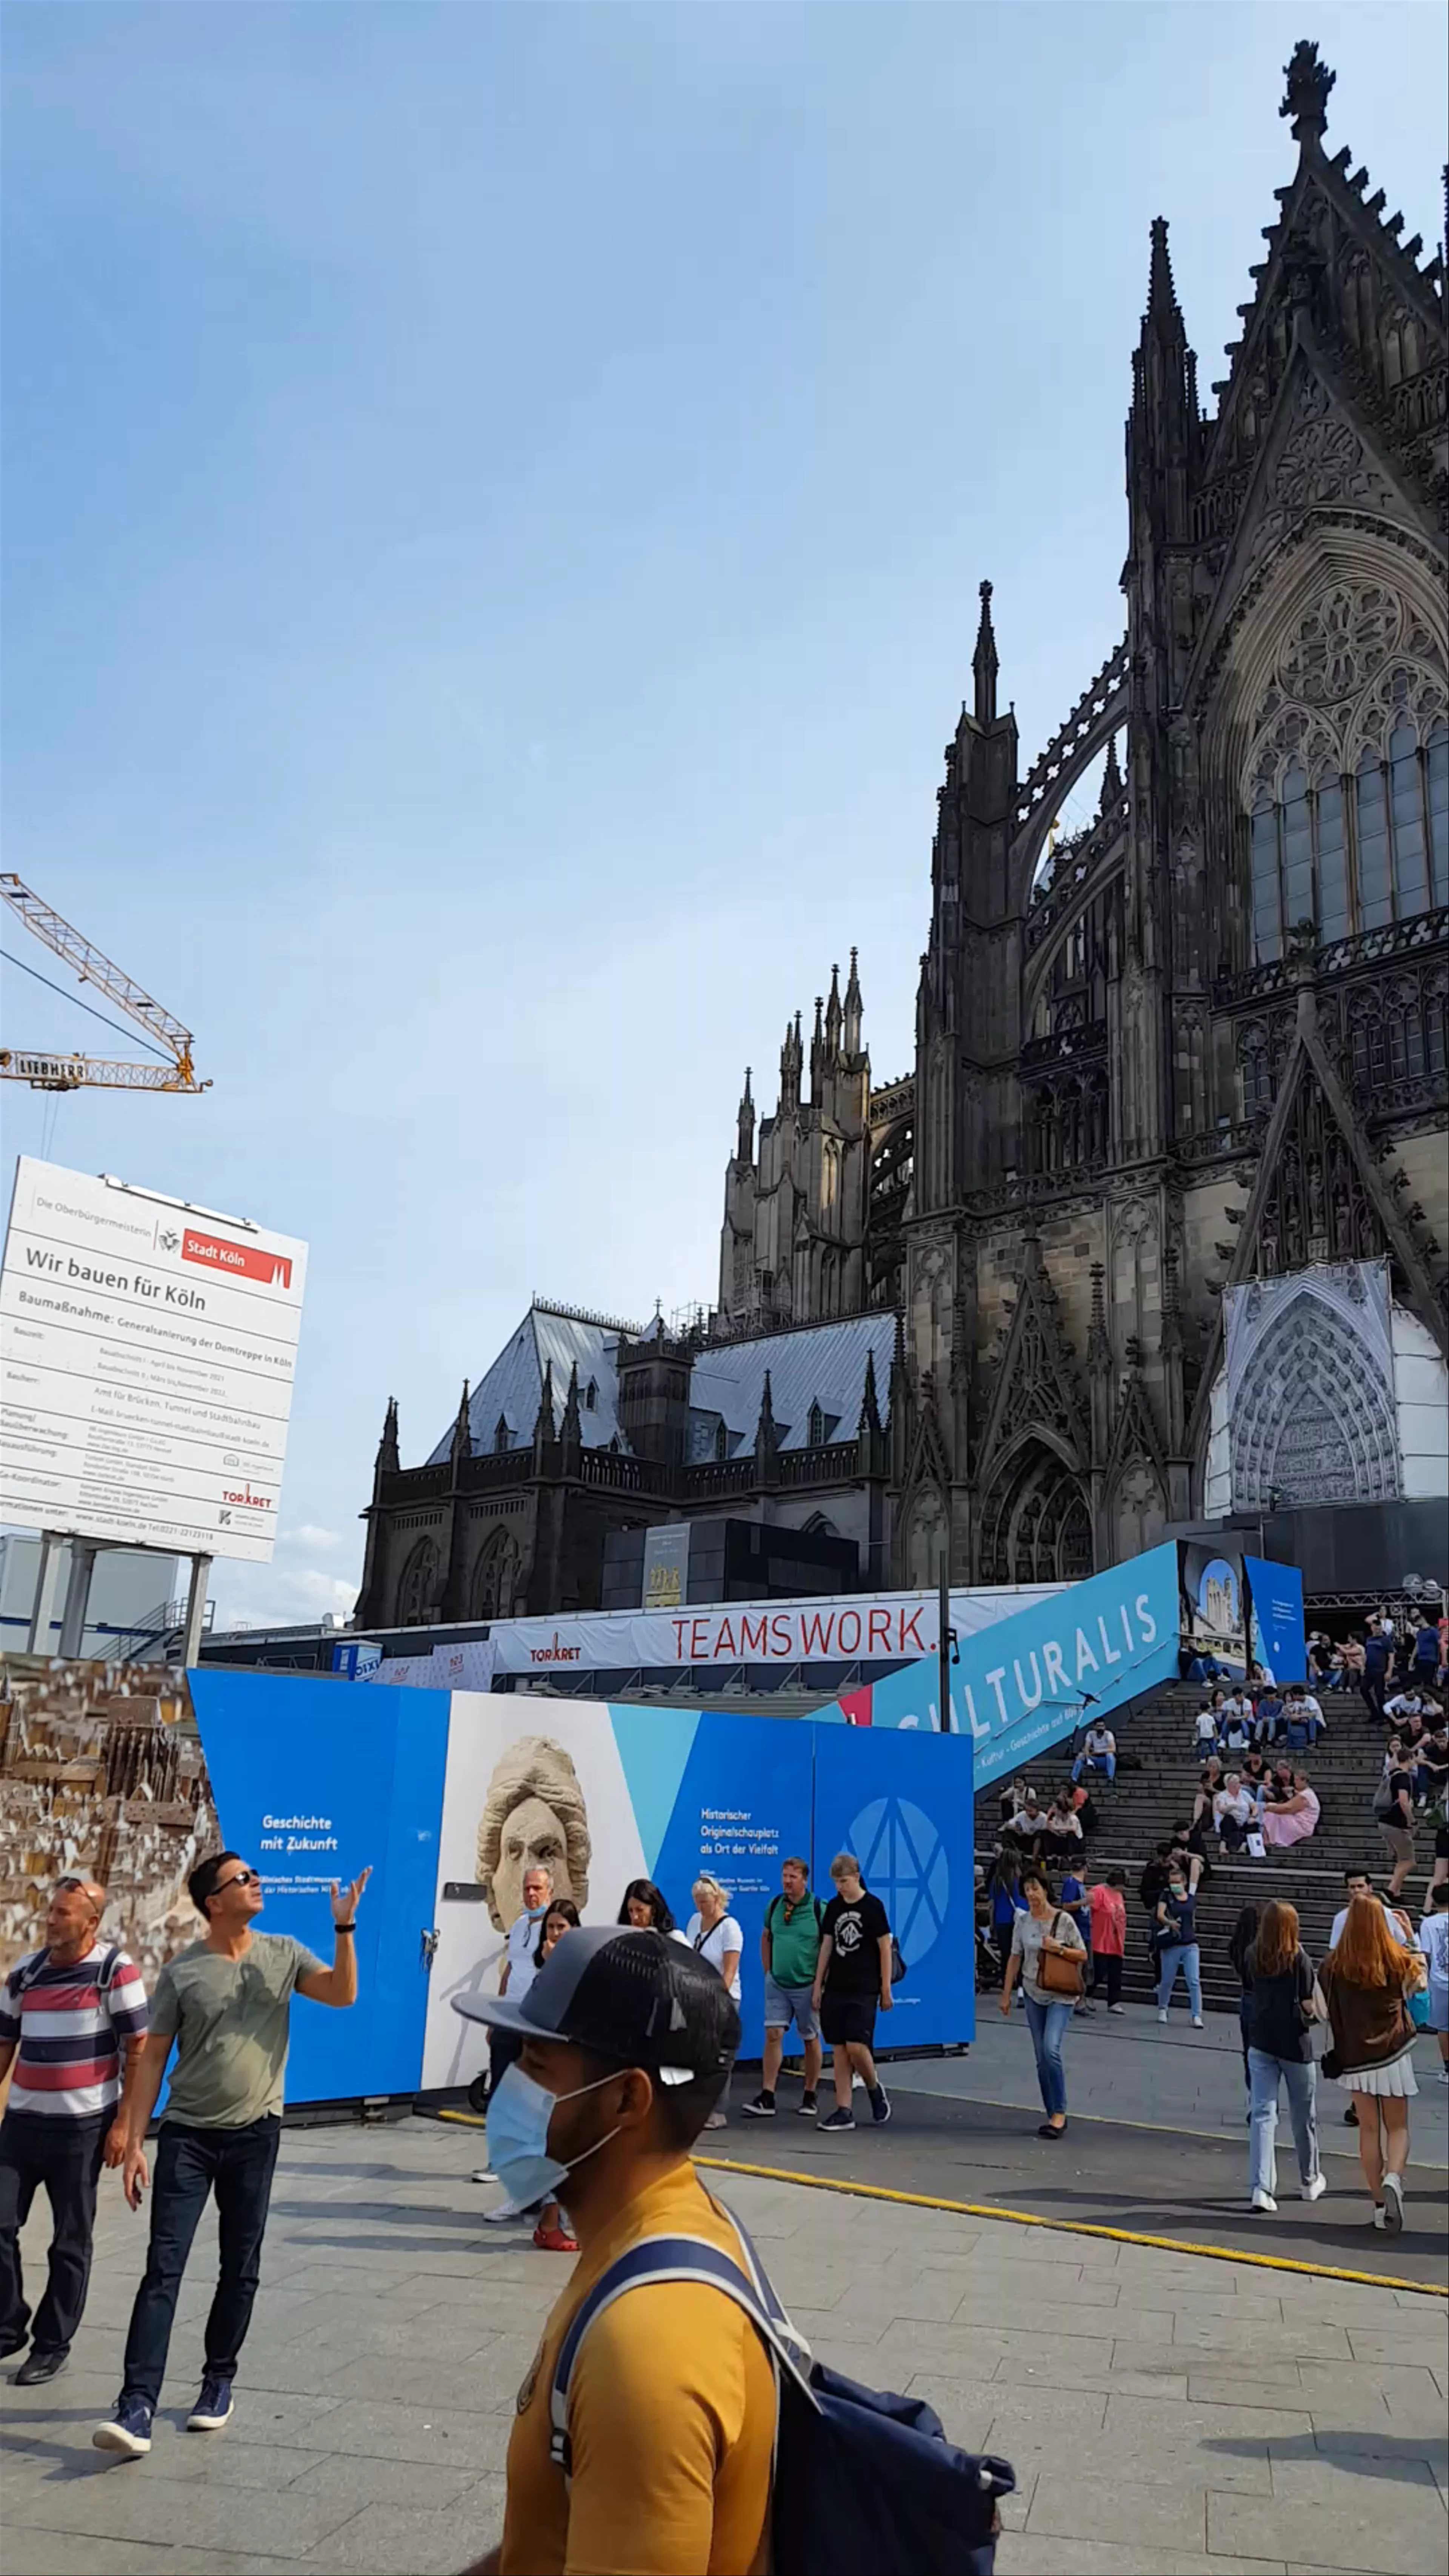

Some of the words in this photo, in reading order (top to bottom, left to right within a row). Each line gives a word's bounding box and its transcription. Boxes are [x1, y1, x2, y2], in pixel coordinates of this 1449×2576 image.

[20, 1060, 83, 1077] LIEBHERR
[37, 1197, 52, 1210] Die
[55, 1203, 151, 1237] Oberbürgermeisterin
[187, 1240, 218, 1260] Stadt
[219, 1250, 245, 1267] Köln
[26, 1247, 63, 1272] Wir
[68, 1258, 128, 1290] bauen
[134, 1276, 161, 1298] für
[165, 1285, 206, 1310] Köln
[19, 1291, 114, 1324] Baumaßnahme:
[117, 1318, 197, 1346] Generalsanierung
[199, 1337, 213, 1349] der
[215, 1342, 263, 1361] Domtreppe
[265, 1354, 272, 1363] in
[274, 1357, 292, 1368] Köln
[95, 1388, 111, 1398] Amt
[114, 1390, 125, 1400] für
[165, 1401, 191, 1415] Tunnel
[223, 1483, 271, 1507] TORKRET
[530, 1632, 581, 1662] TORKRET
[262, 1814, 332, 1830] Geschichte
[700, 1808, 751, 1820] Historischer
[260, 1835, 283, 1850] mit
[286, 1836, 338, 1850] Zukunft
[700, 1825, 779, 1840] Originalschauplatz
[700, 1843, 713, 1854] als
[714, 1844, 730, 1854] Ort
[732, 1844, 746, 1854] der
[749, 1844, 778, 1855] Vielfalt
